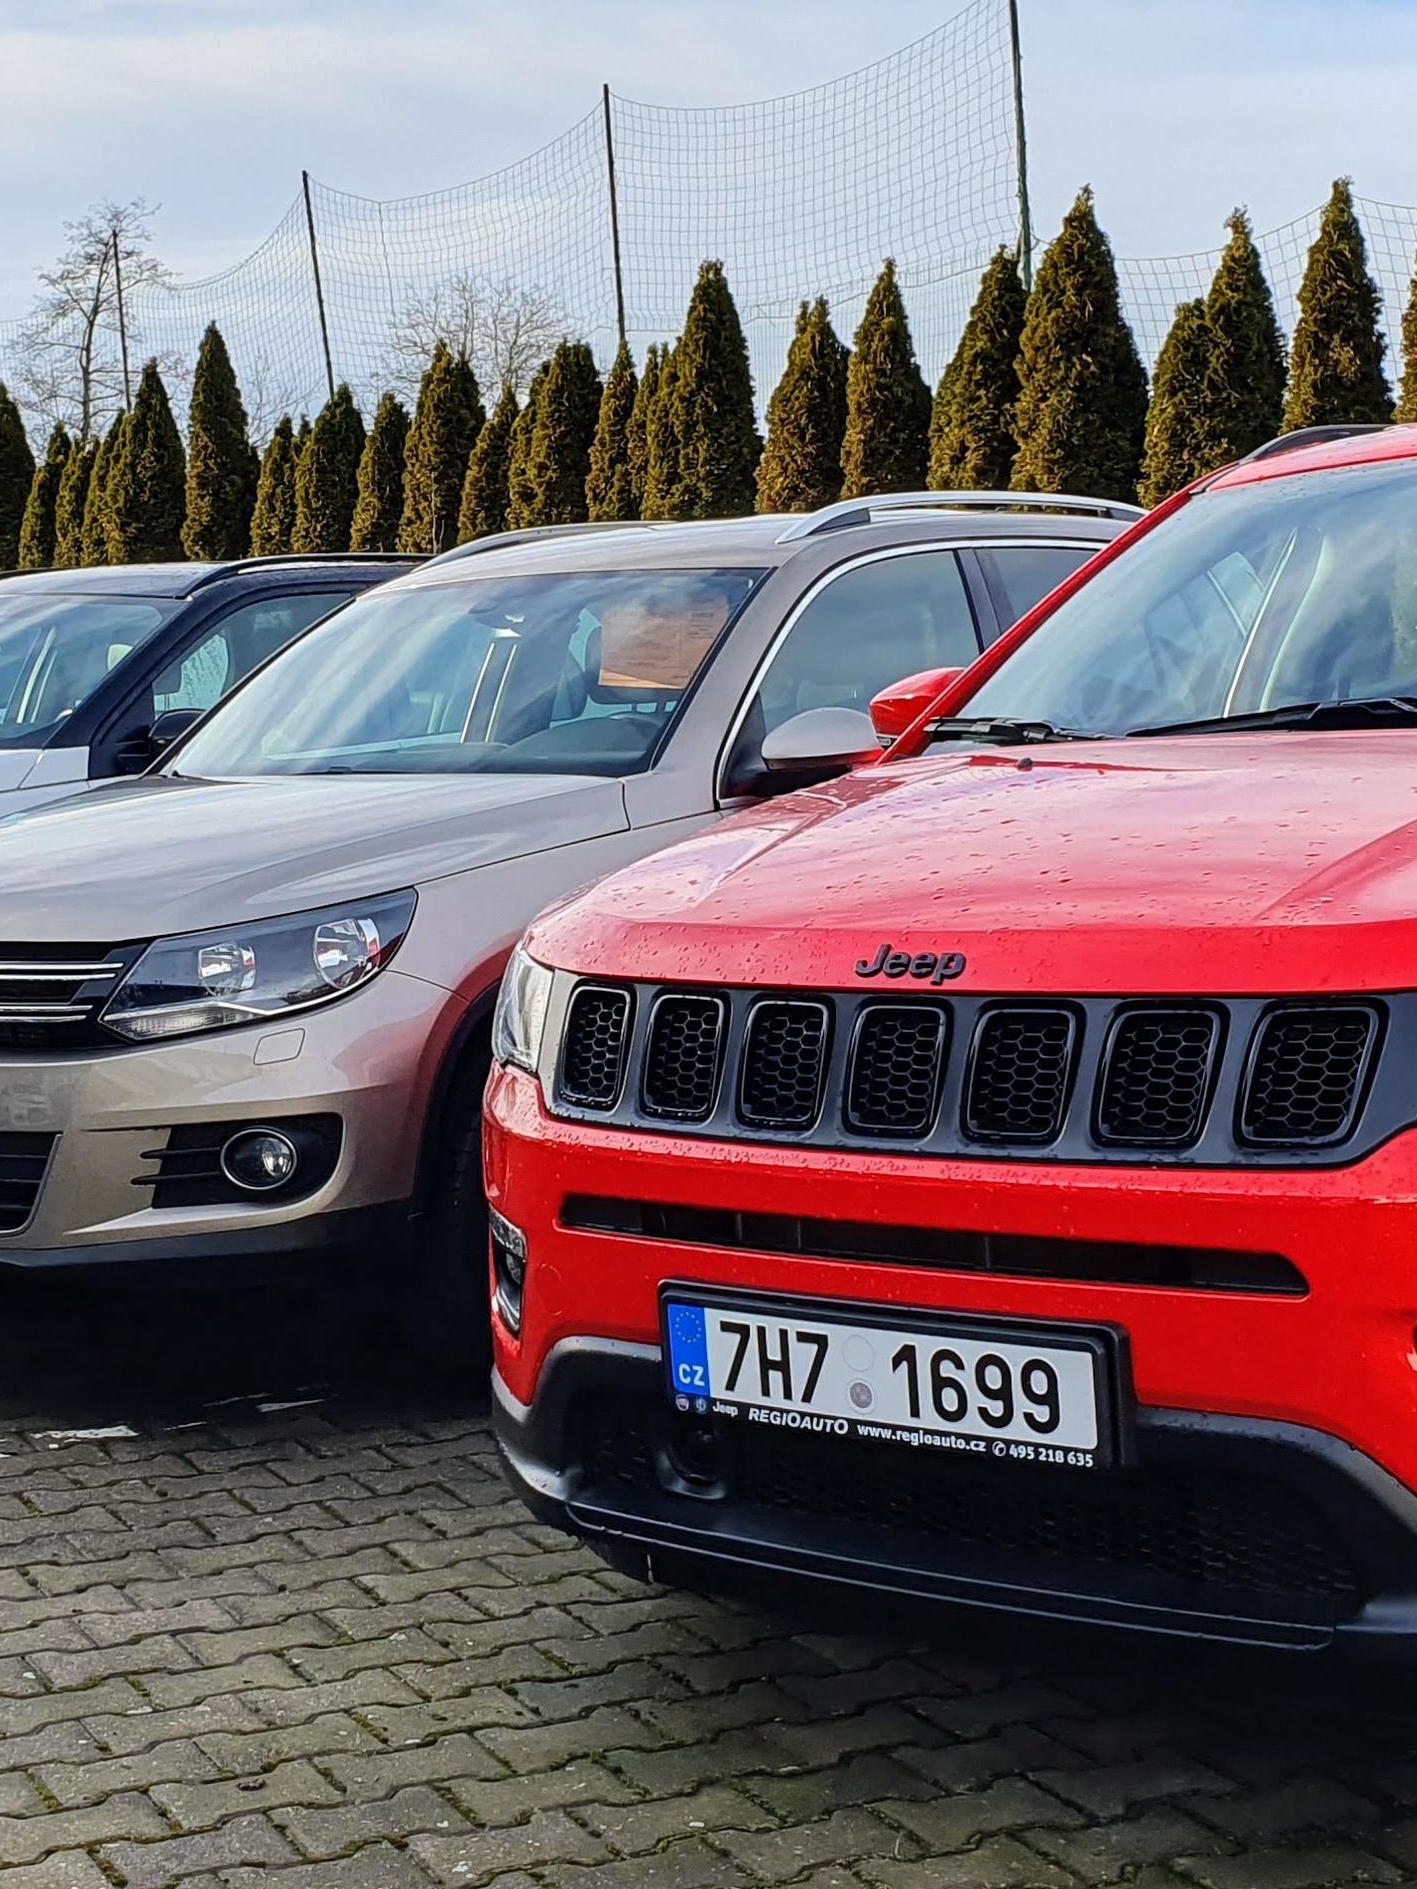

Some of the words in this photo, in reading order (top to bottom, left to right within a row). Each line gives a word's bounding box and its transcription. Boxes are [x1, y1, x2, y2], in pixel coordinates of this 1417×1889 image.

[855, 944, 967, 986] Jeep
[678, 1362, 706, 1388] CZ
[719, 1320, 829, 1405] 7H7
[891, 1343, 1060, 1435] 1699
[712, 1400, 739, 1418] Jeep
[748, 1407, 849, 1436] REGIOAUTO
[857, 1422, 986, 1452] www.regioauto.cz
[1009, 1444, 1034, 1460] 495
[1038, 1448, 1065, 1463] 218
[1067, 1451, 1094, 1467] 635
